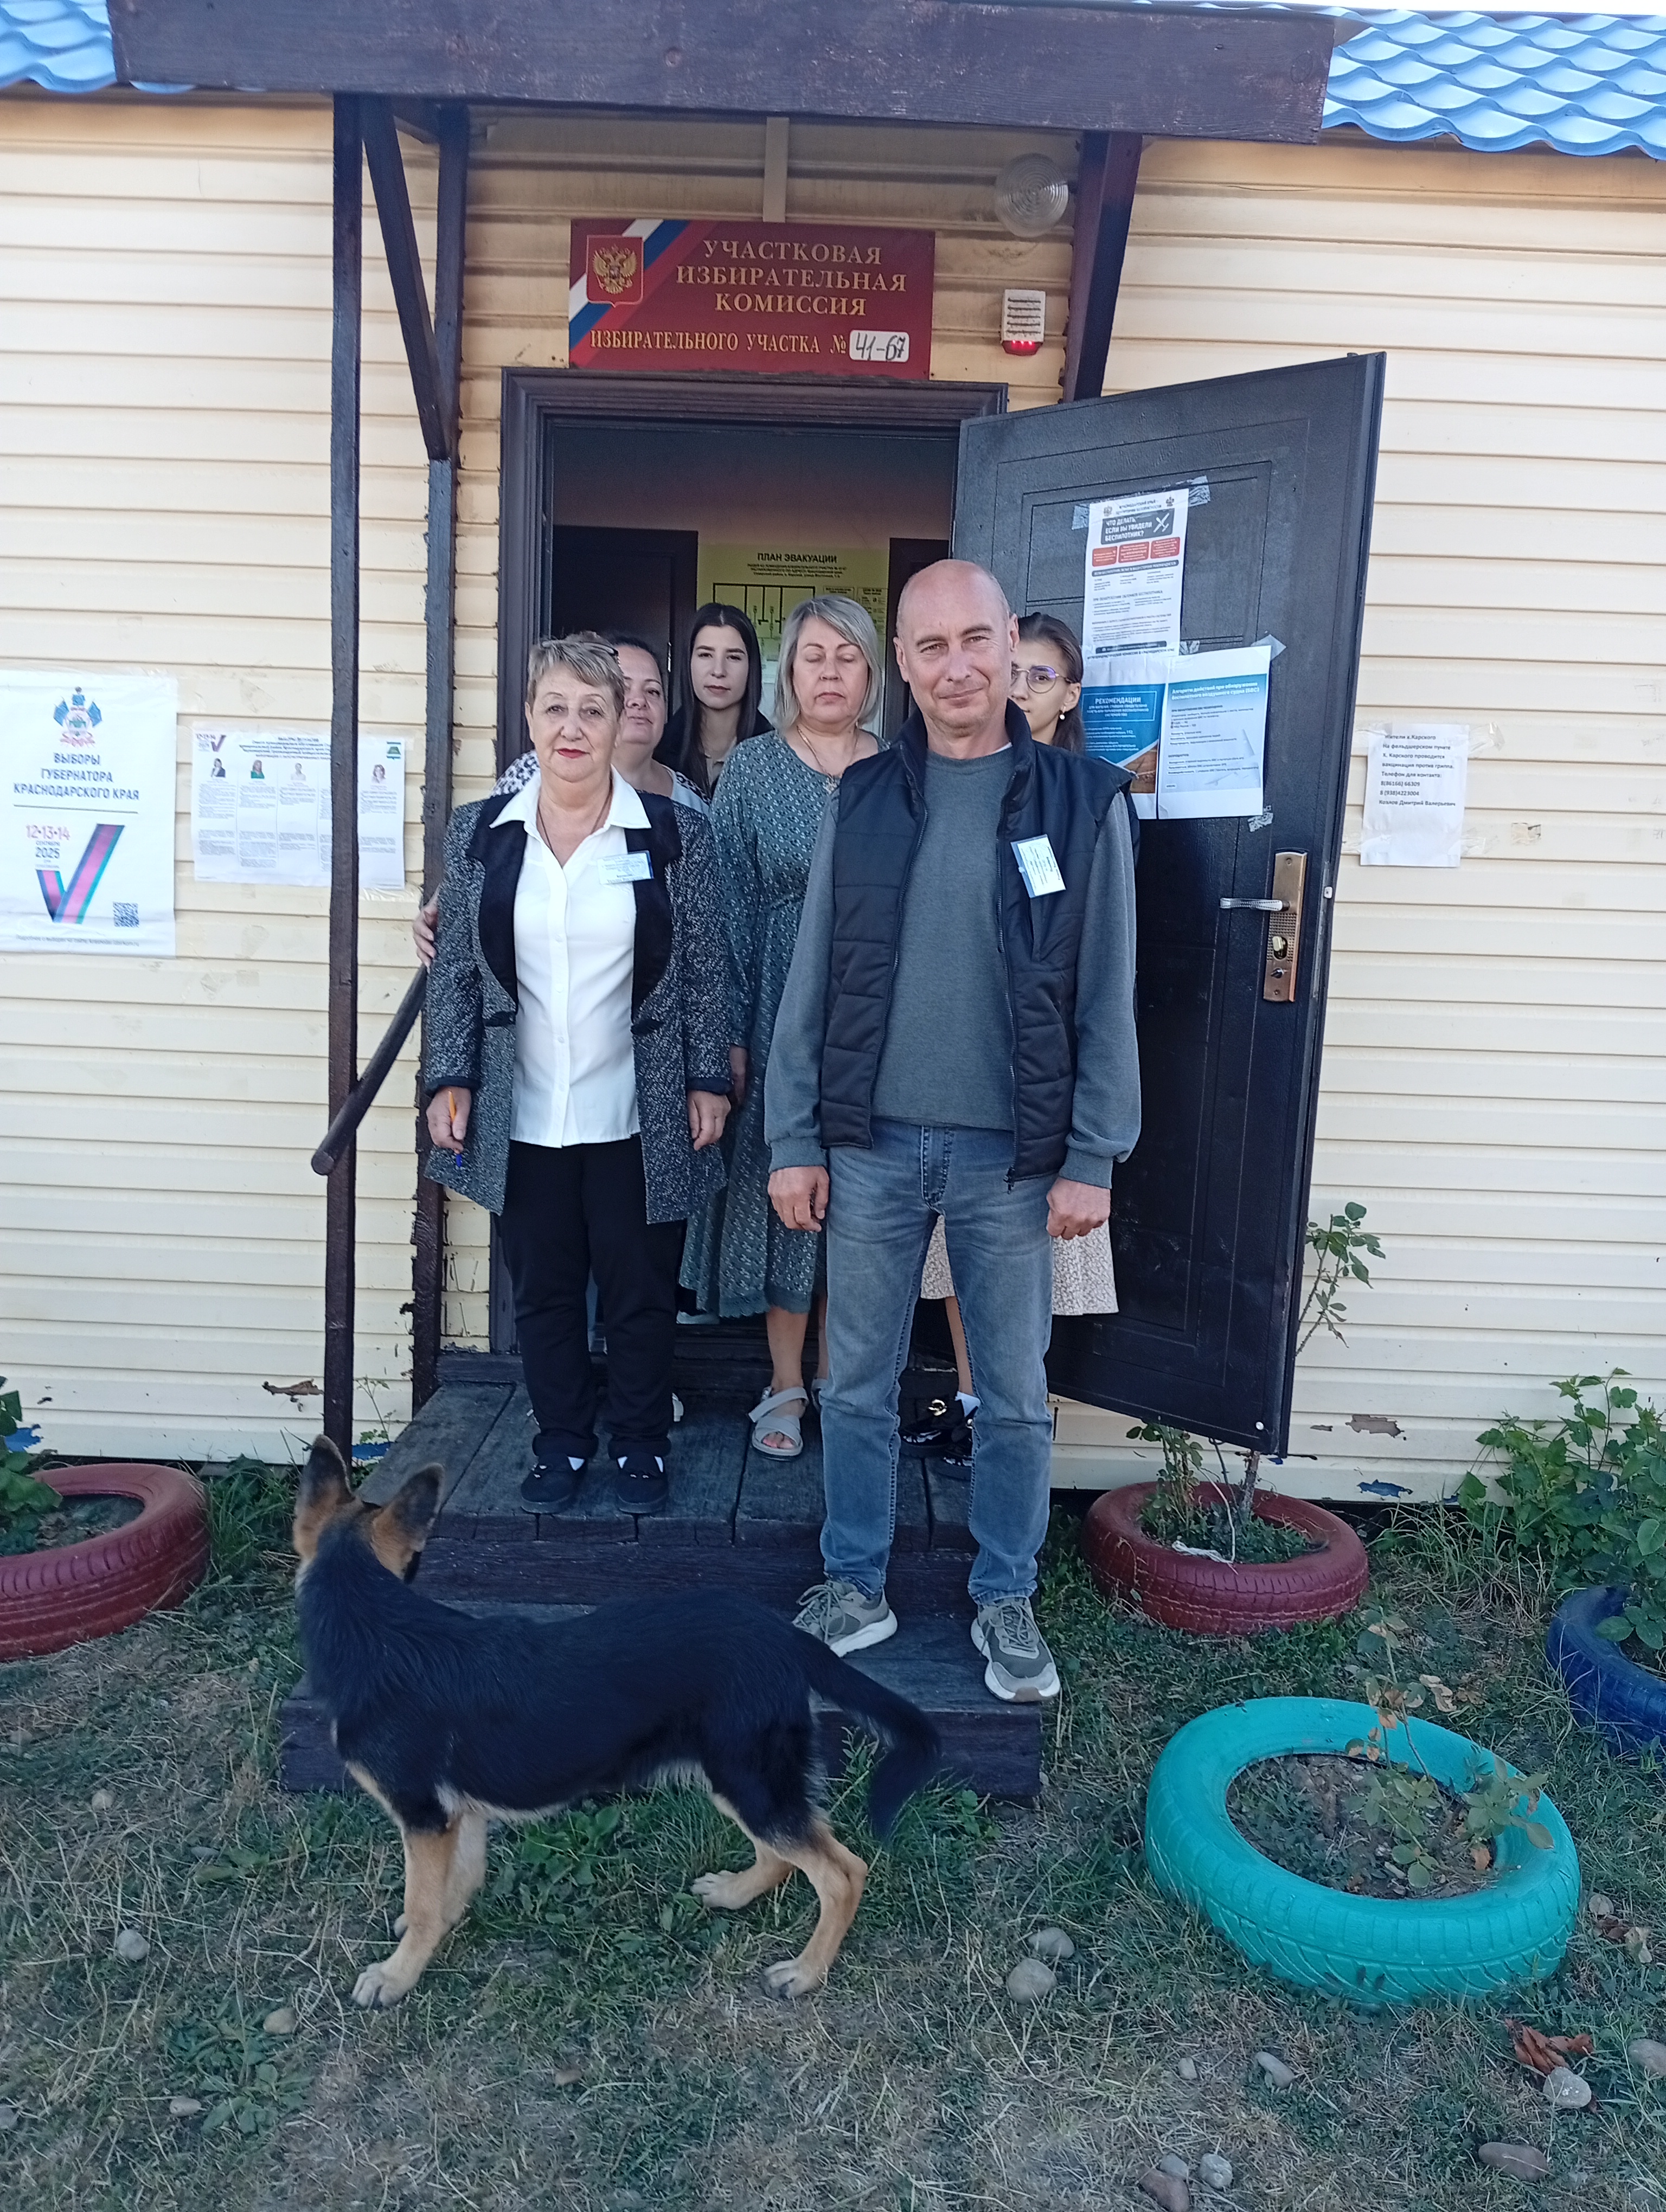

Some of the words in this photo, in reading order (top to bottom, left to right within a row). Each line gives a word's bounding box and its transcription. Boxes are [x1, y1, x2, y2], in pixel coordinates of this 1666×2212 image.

[703, 240, 882, 265] УЧАСТКОВАЯ
[676, 265, 906, 292] ИЗБИРАТЕЛЬНАЯ
[715, 293, 867, 316] КОМИССИЯ
[590, 330, 739, 350] ИЗБИРАТЕЛЬНОГО
[746, 333, 820, 353] УЧАСТКА
[829, 335, 848, 354] №
[1129, 522, 1152, 530] УВИДЕЛИ
[1105, 531, 1144, 542] БЕСПИЛОТНИК?
[758, 553, 782, 561] ПЛАН
[784, 554, 837, 563] ЭВАКУАЦИИ
[54, 753, 100, 765] ВЫБОРЫ
[41, 768, 113, 782] ГУБЕРНАТОРА
[14, 783, 110, 799] КРАСНОДАРСКОГО
[112, 788, 139, 800] КРАЯ
[35, 847, 60, 859] 2025
